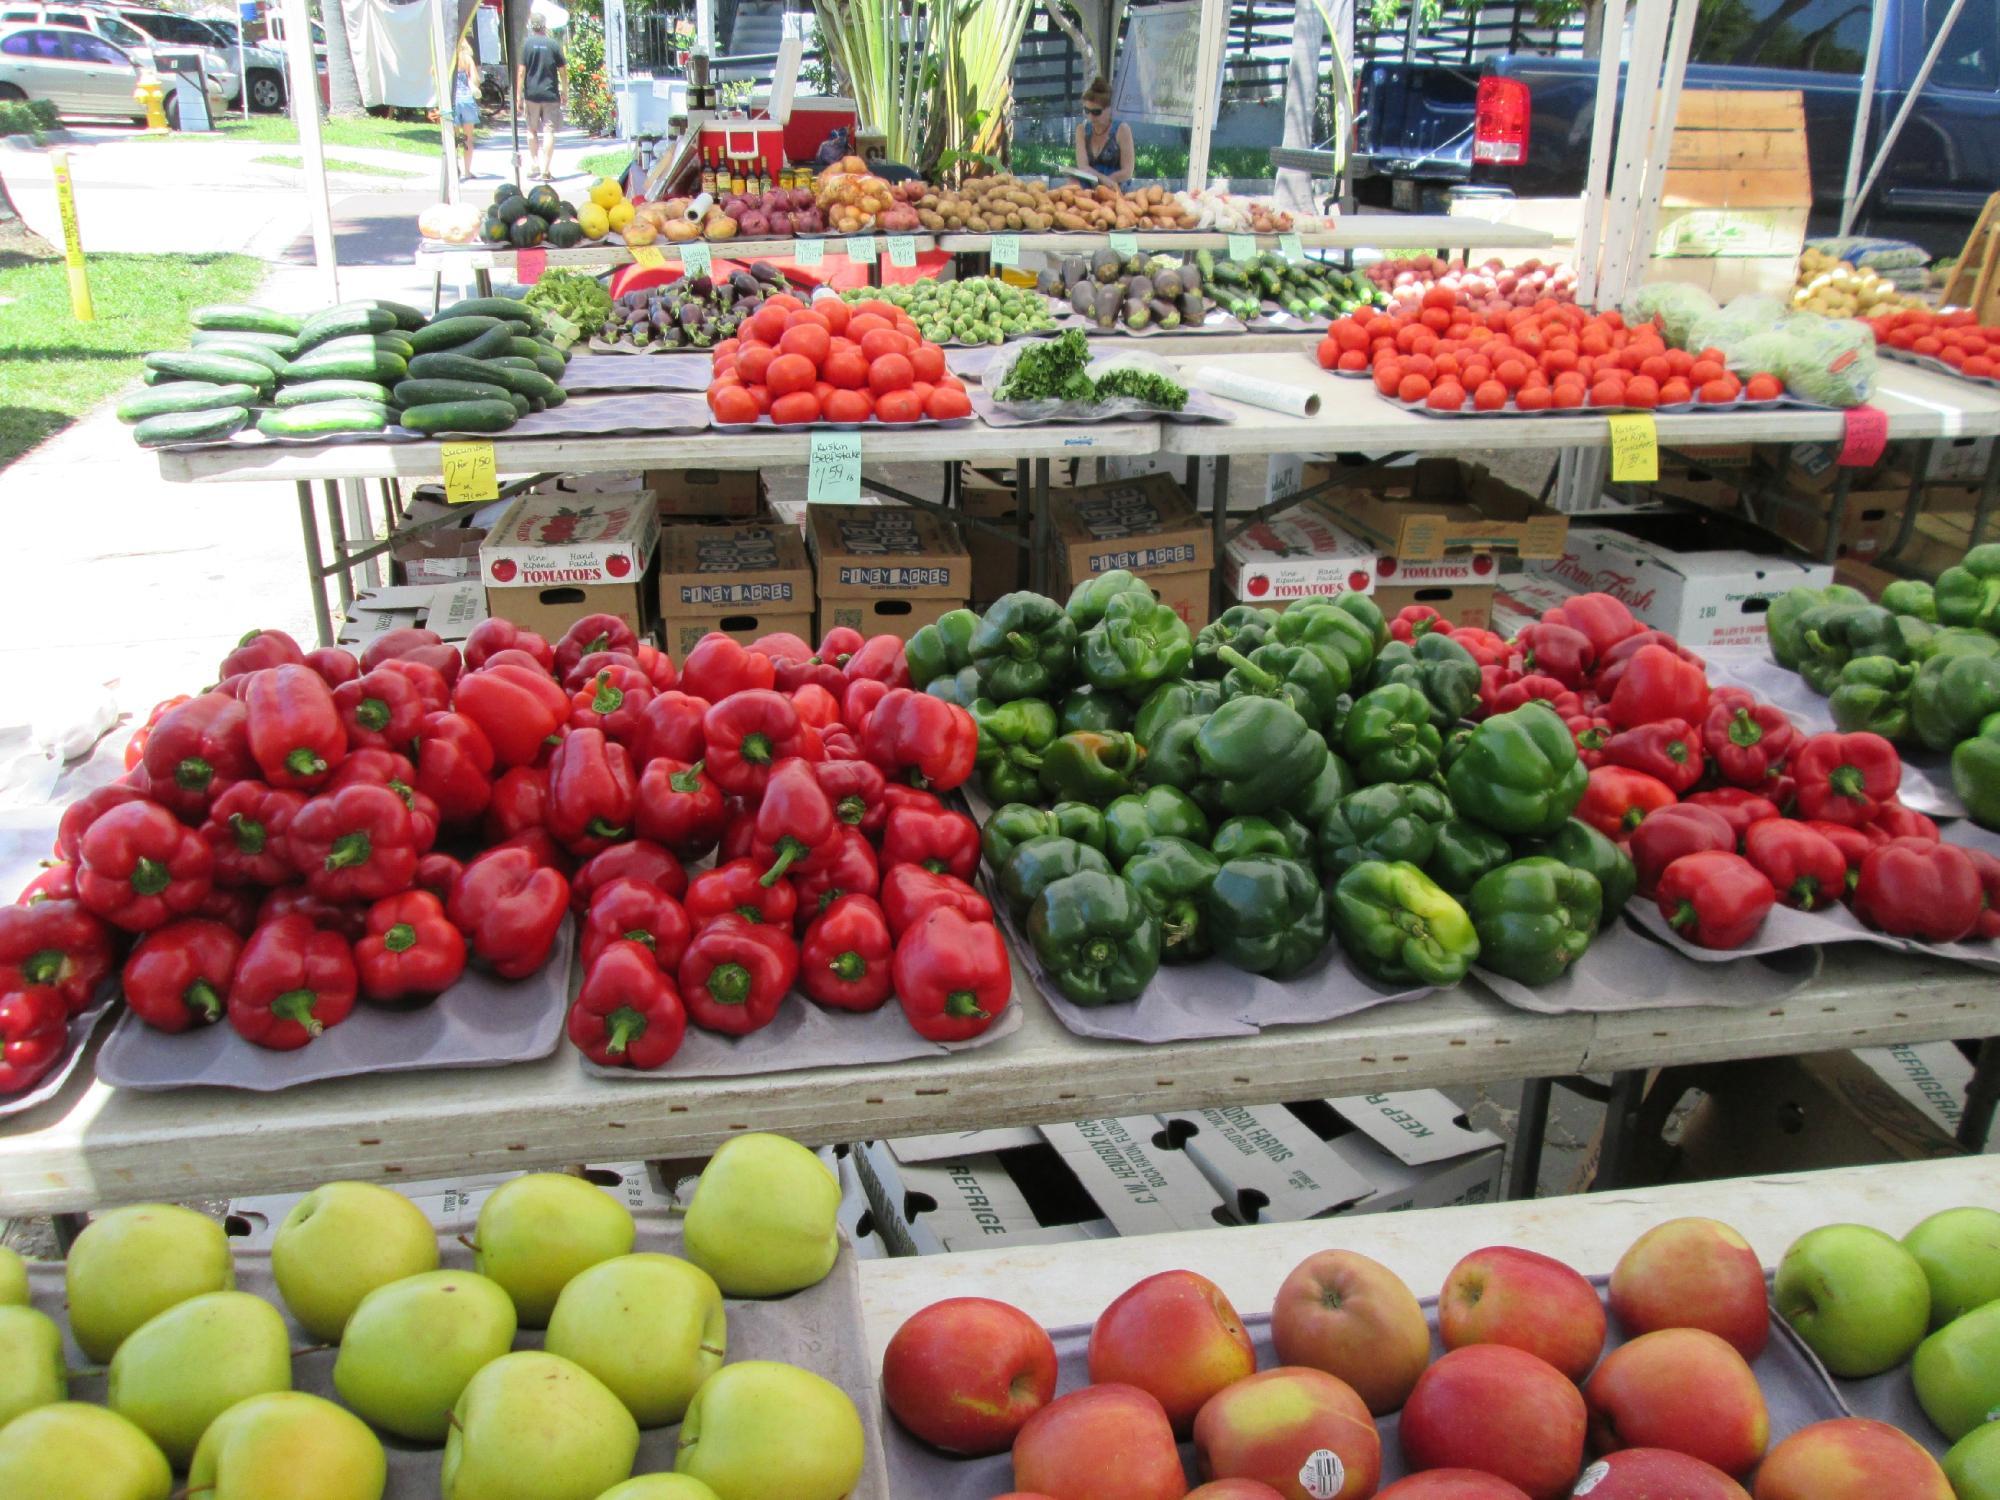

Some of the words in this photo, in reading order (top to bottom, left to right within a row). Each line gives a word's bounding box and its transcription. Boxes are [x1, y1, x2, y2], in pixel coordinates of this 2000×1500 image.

[817, 442, 848, 451] Ruskin
[445, 460, 460, 488] 2
[523, 561, 557, 570] Ripened
[569, 559, 600, 567] Packed
[1090, 552, 1139, 571] PINEY
[1147, 545, 1194, 563] ACRES
[521, 567, 602, 584] TOMATOES
[840, 567, 891, 585] PINEY
[900, 566, 949, 584] ACRES
[1401, 566, 1469, 579] TOMATOES
[1541, 553, 1596, 590] Farm
[1596, 569, 1657, 612] Fresh
[681, 586, 730, 603] PINEY
[741, 583, 792, 601] ACRES
[1273, 583, 1344, 597] TOMATOES
[1380, 1106, 1434, 1138] KEEP
[1223, 1127, 1258, 1156] FLORIDA
[1246, 1128, 1294, 1162] FARMS
[1088, 1138, 1139, 1180] HENDRIX
[1140, 1166, 1168, 1188] BOCA
[946, 1164, 1007, 1235] REFRIGE
